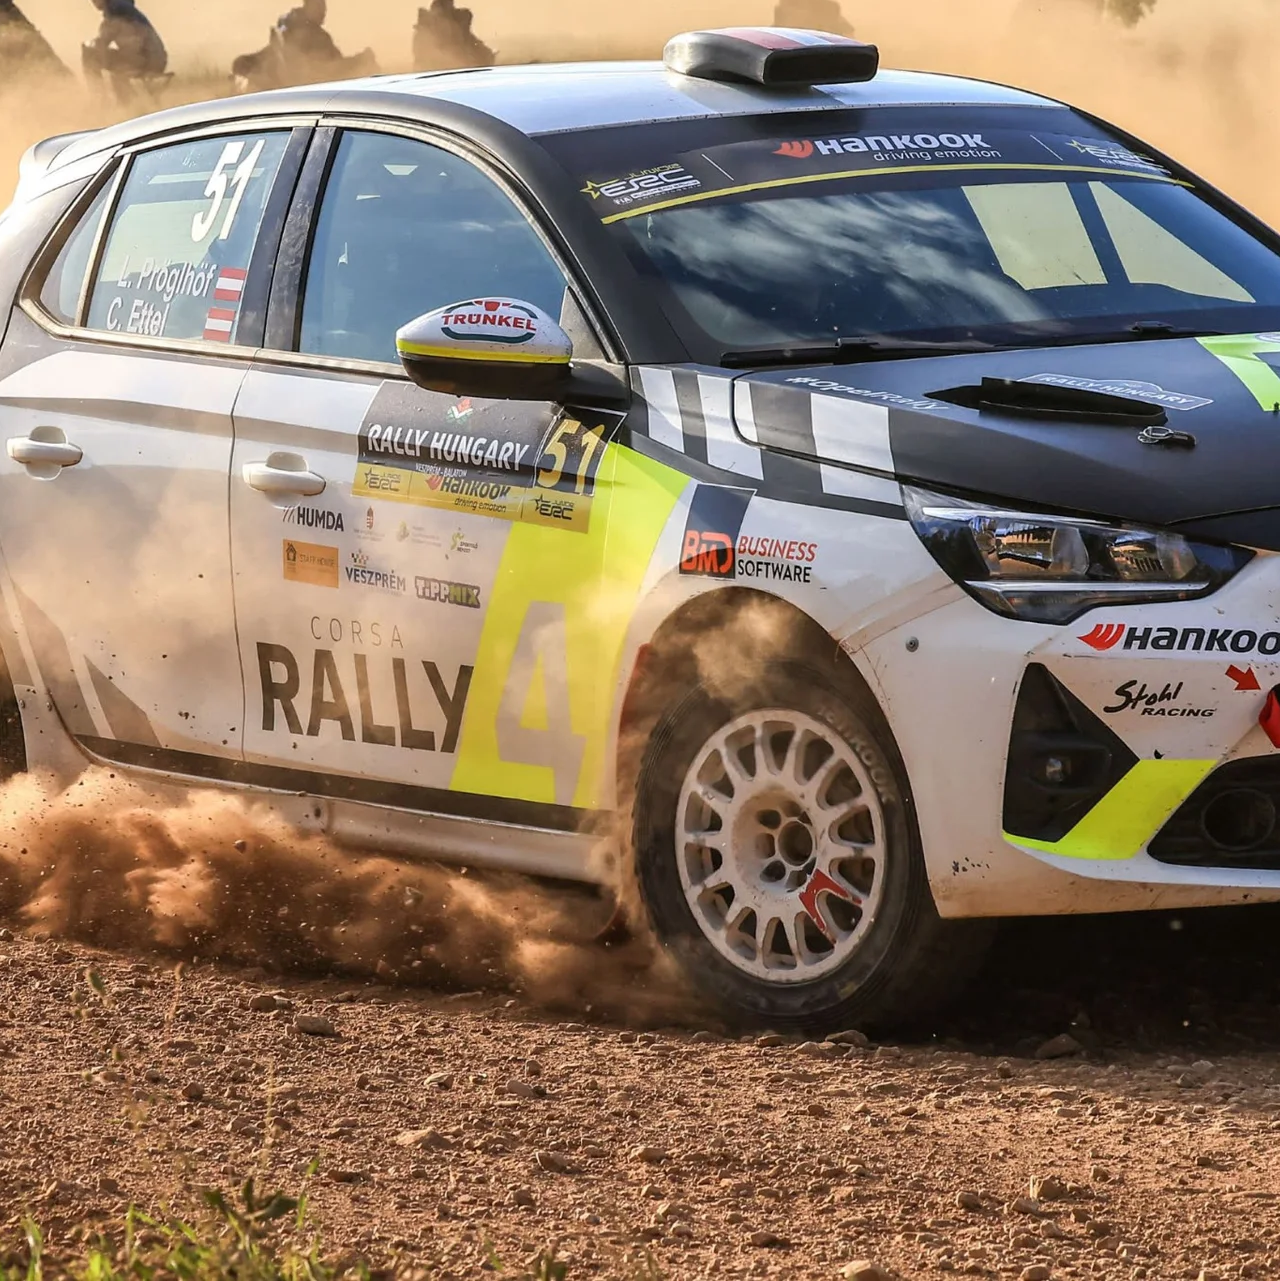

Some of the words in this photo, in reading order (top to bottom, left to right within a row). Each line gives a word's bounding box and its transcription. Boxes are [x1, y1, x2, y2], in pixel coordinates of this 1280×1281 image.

[873, 149, 931, 161] driving
[936, 148, 1002, 158] emotion
[191, 139, 266, 243] 51
[136, 257, 217, 303] Pröglhöf
[107, 296, 123, 331] C.
[127, 299, 170, 337] Ettel
[441, 313, 537, 332] TRÜNKEL
[784, 376, 950, 410] #OpelRally
[1039, 375, 1104, 390] RALLY
[1100, 384, 1196, 405] HUNGARY
[368, 423, 429, 457] RALLY
[430, 431, 530, 471] HUNGARY
[537, 419, 606, 496] 51
[297, 506, 345, 532] HUMDA
[454, 497, 477, 511] driving
[478, 503, 507, 513] emotion
[738, 536, 818, 562] BUSINESS
[345, 566, 406, 592] VESZPRÉM
[737, 559, 813, 583] SOFTWARE
[310, 615, 404, 649] CORSA
[256, 641, 474, 754] RALLY
[494, 599, 587, 808] 4
[1103, 679, 1184, 714] Stohl
[1140, 707, 1217, 717] RACING
